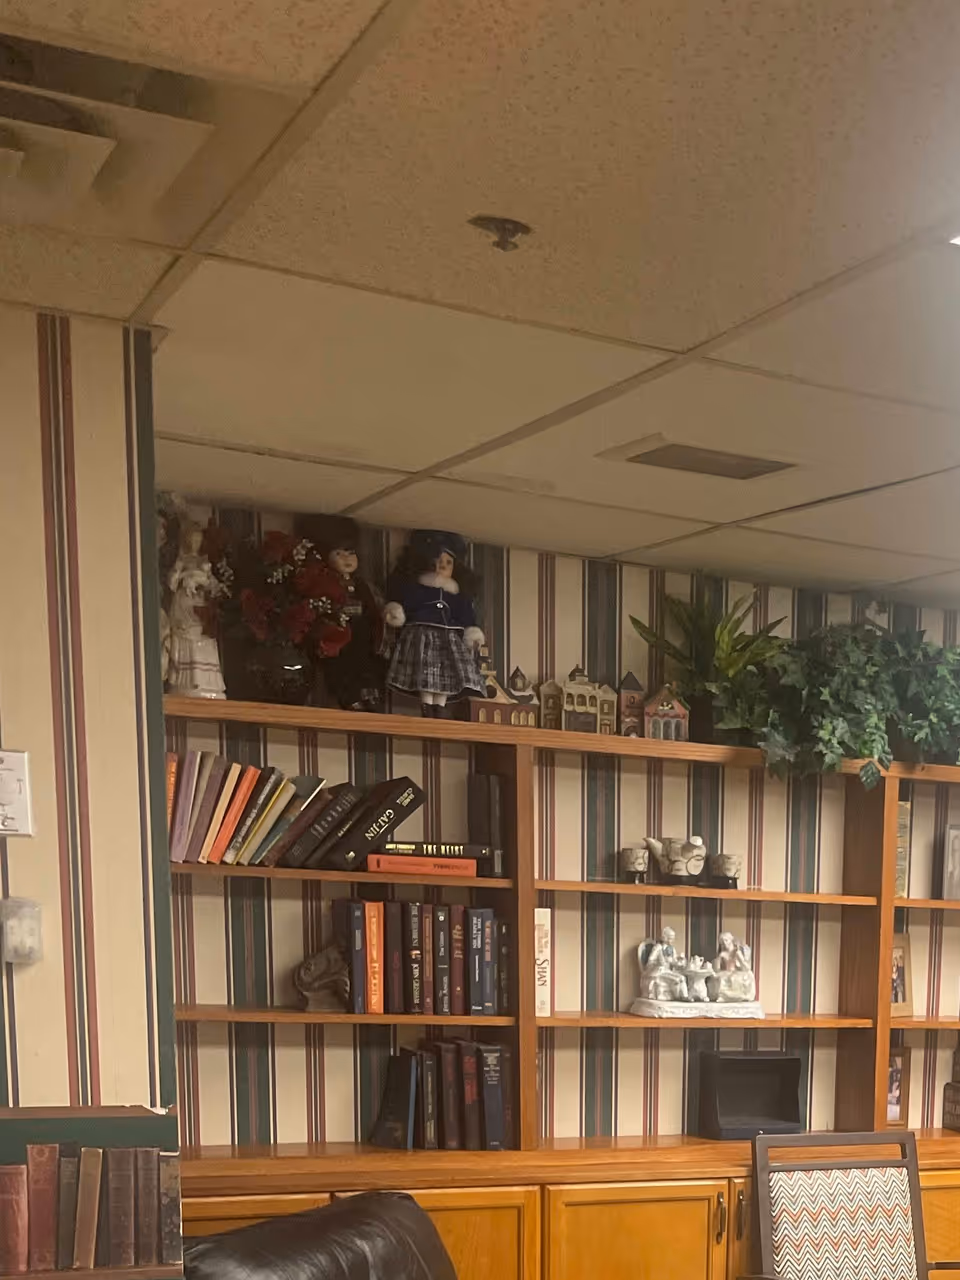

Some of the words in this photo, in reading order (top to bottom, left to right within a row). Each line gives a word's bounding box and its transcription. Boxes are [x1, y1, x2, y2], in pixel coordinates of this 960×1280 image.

[364, 809, 395, 841] GAI-JIN
[422, 844, 437, 856] THE
[440, 845, 464, 856] HEIST
[535, 958, 549, 987] SHAN
